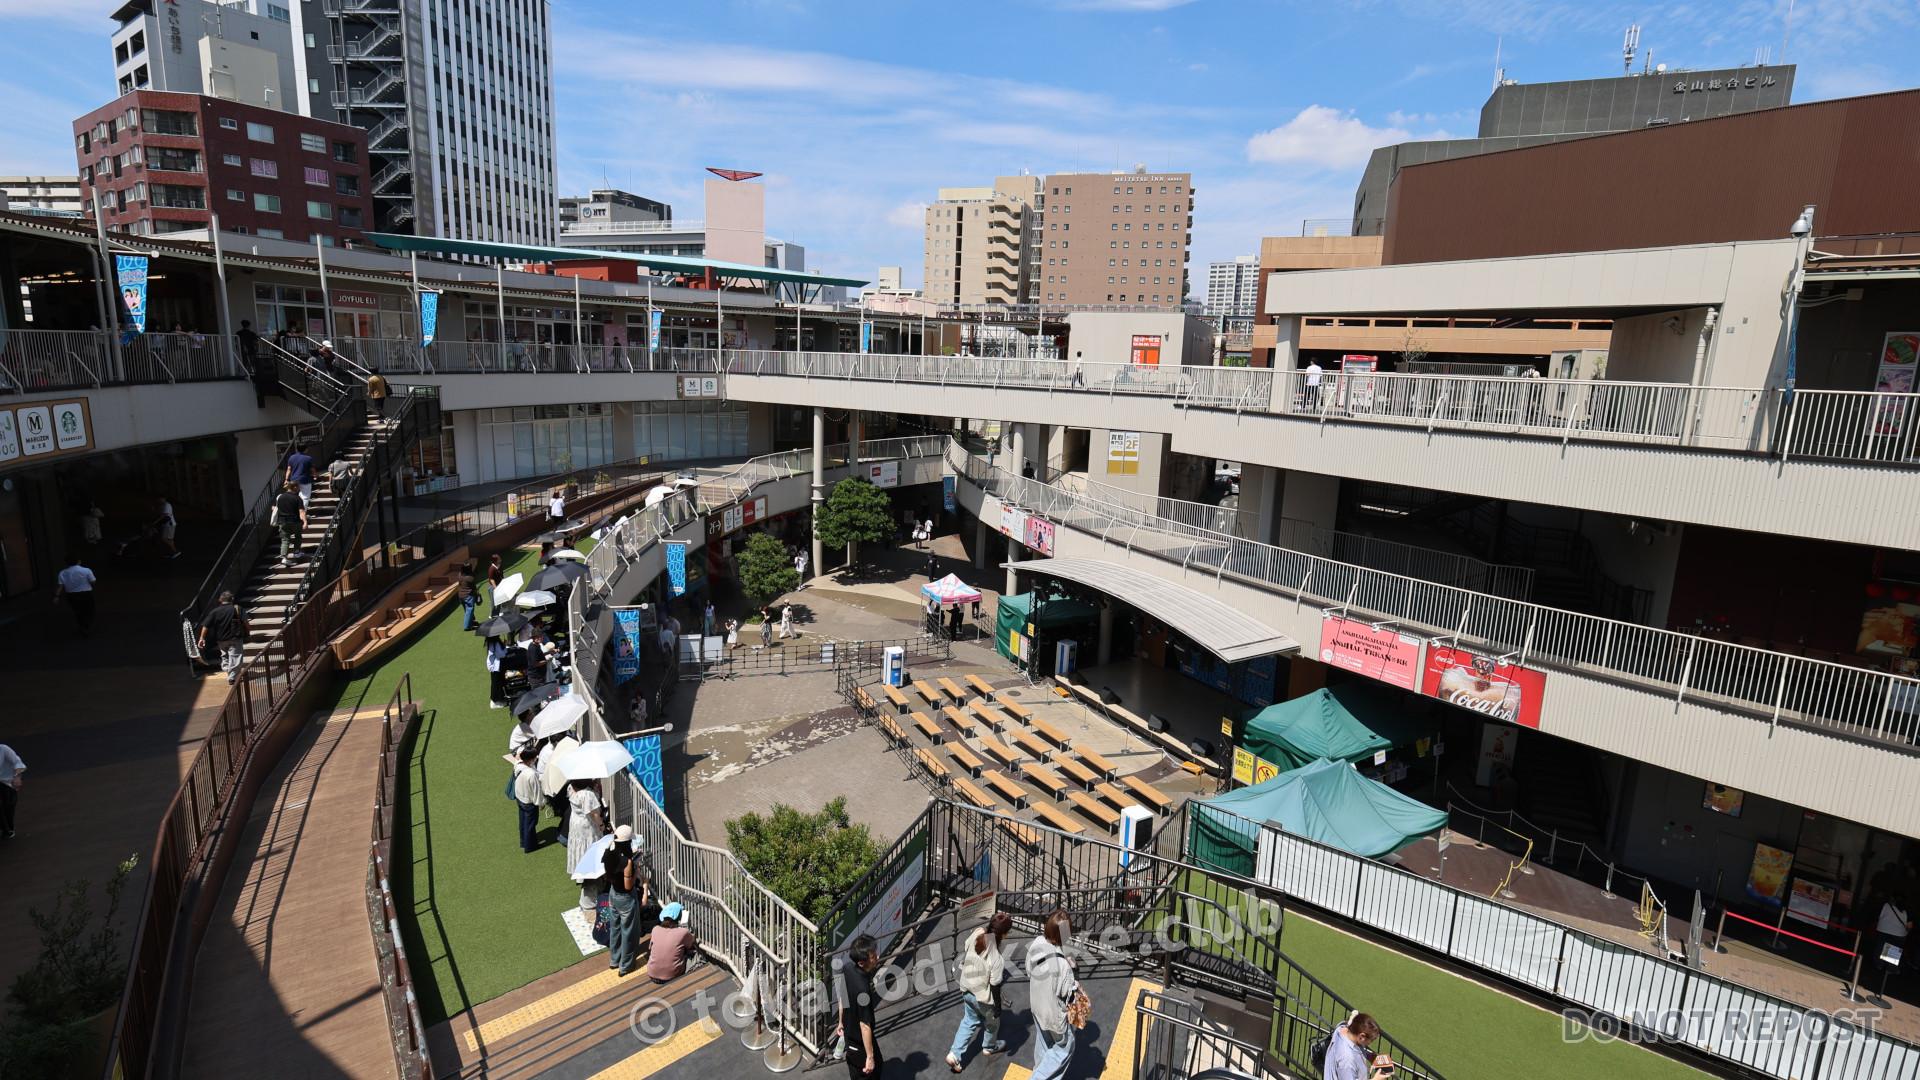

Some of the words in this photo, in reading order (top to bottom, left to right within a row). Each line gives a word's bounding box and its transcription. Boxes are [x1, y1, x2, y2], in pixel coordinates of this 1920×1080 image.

[1673, 75, 1776, 93] 金山総合ビル
[593, 208, 606, 216] NTT
[338, 295, 364, 304] JOYFUL
[28, 415, 41, 431] M
[26, 435, 49, 443] MARUZEN
[1125, 440, 1139, 450] 2F
